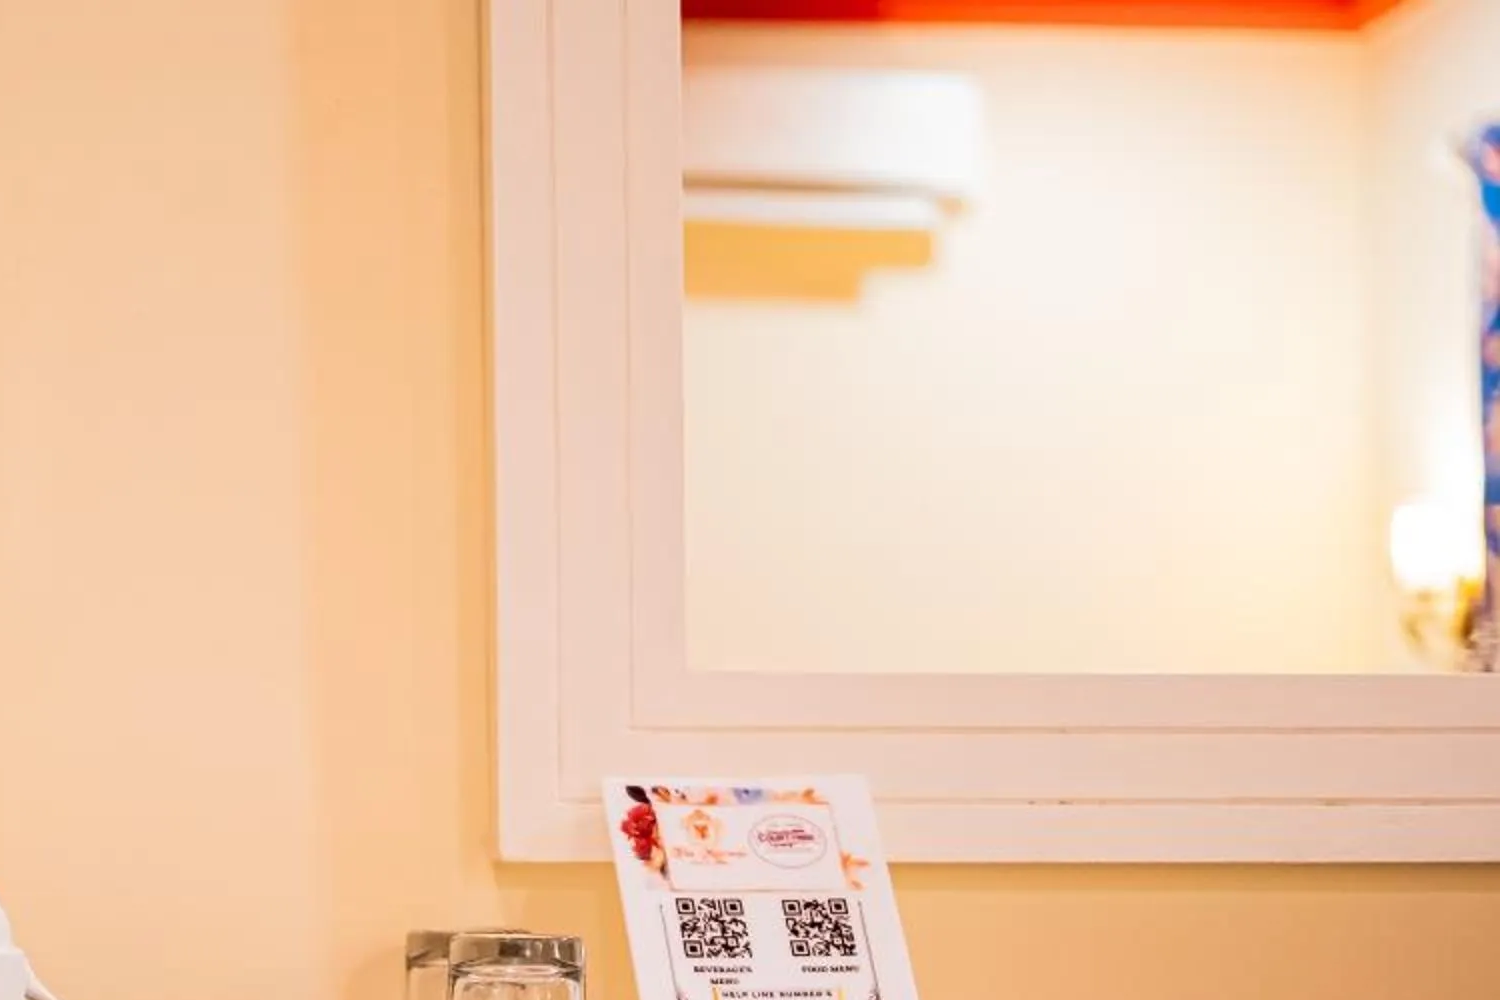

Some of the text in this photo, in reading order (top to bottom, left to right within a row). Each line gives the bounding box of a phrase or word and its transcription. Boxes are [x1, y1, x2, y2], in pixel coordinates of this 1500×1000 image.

[829, 965, 860, 973] MENU
[721, 990, 748, 998] HELP
[751, 990, 775, 998] LINE
